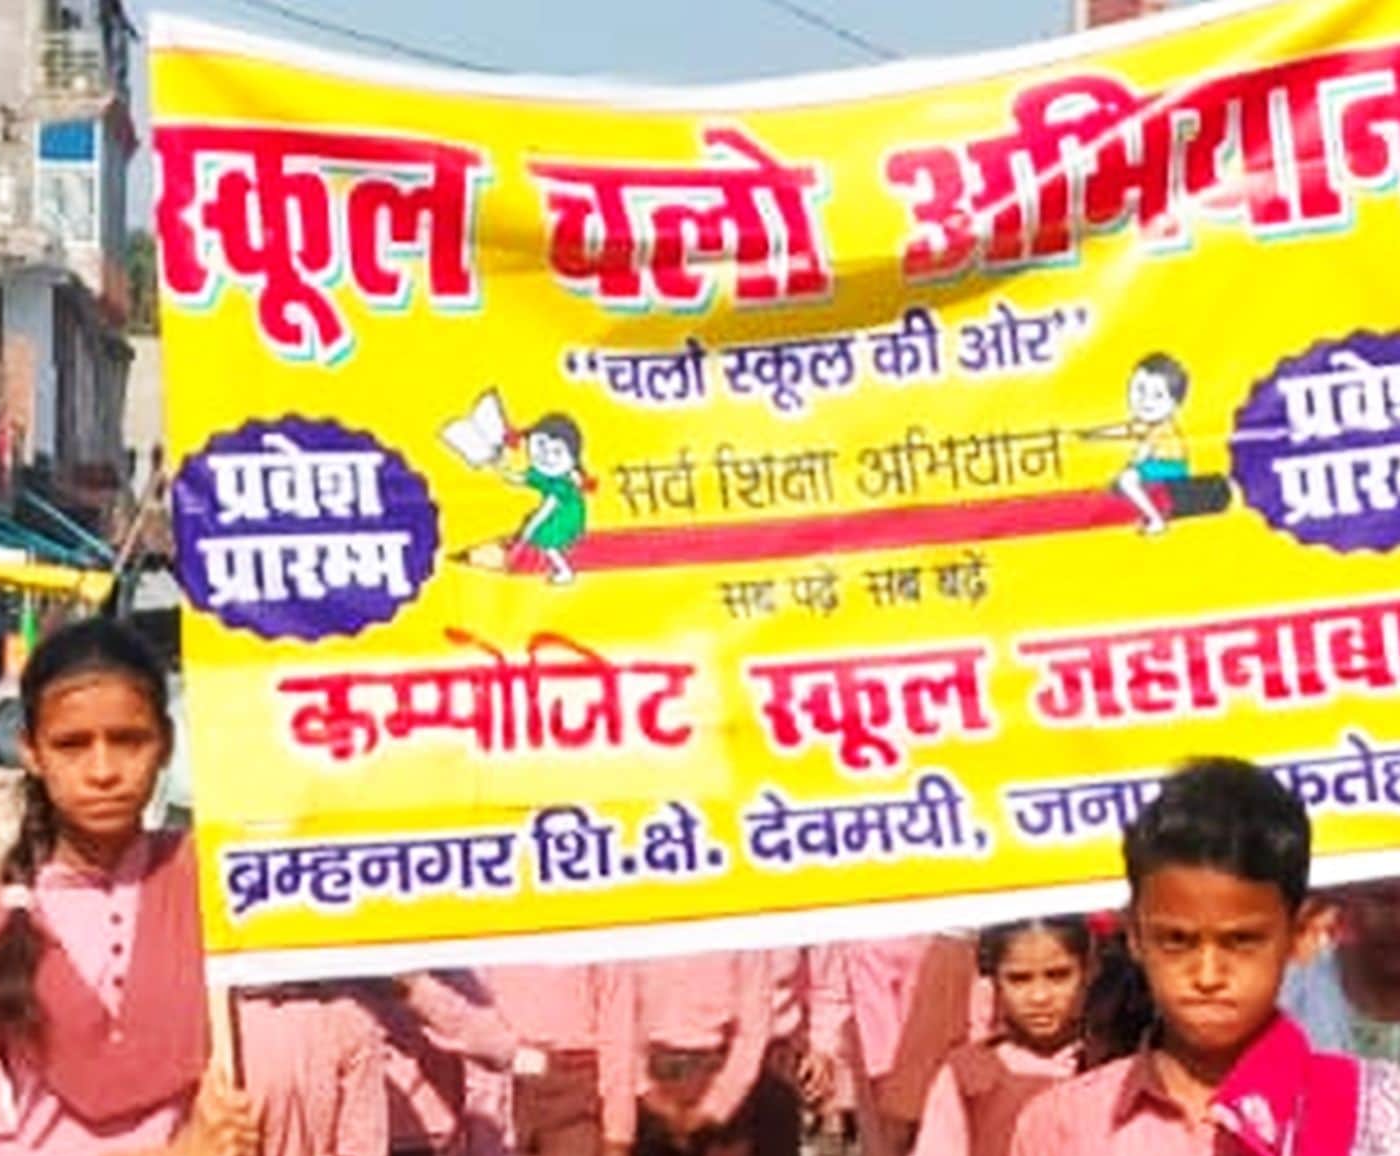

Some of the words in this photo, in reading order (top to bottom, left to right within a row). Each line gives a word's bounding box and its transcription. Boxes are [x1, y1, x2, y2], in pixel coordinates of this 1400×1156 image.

[153, 124, 486, 352] स्कूल
[525, 122, 830, 304] चलो
[724, 335, 856, 411] स्कूल
[871, 306, 942, 379] की
[207, 432, 386, 525] प्रवेश
[614, 445, 697, 516] सर्व
[716, 441, 839, 510] शिक्षा
[855, 425, 1064, 498] अभियान
[195, 530, 413, 607] प्रारम्भ
[863, 566, 922, 607] सब
[276, 626, 698, 760] कम्पोजिट
[748, 646, 991, 771] स्कूल
[224, 831, 517, 916] ब्रम्हनगर
[745, 772, 989, 864] देवमयी,
